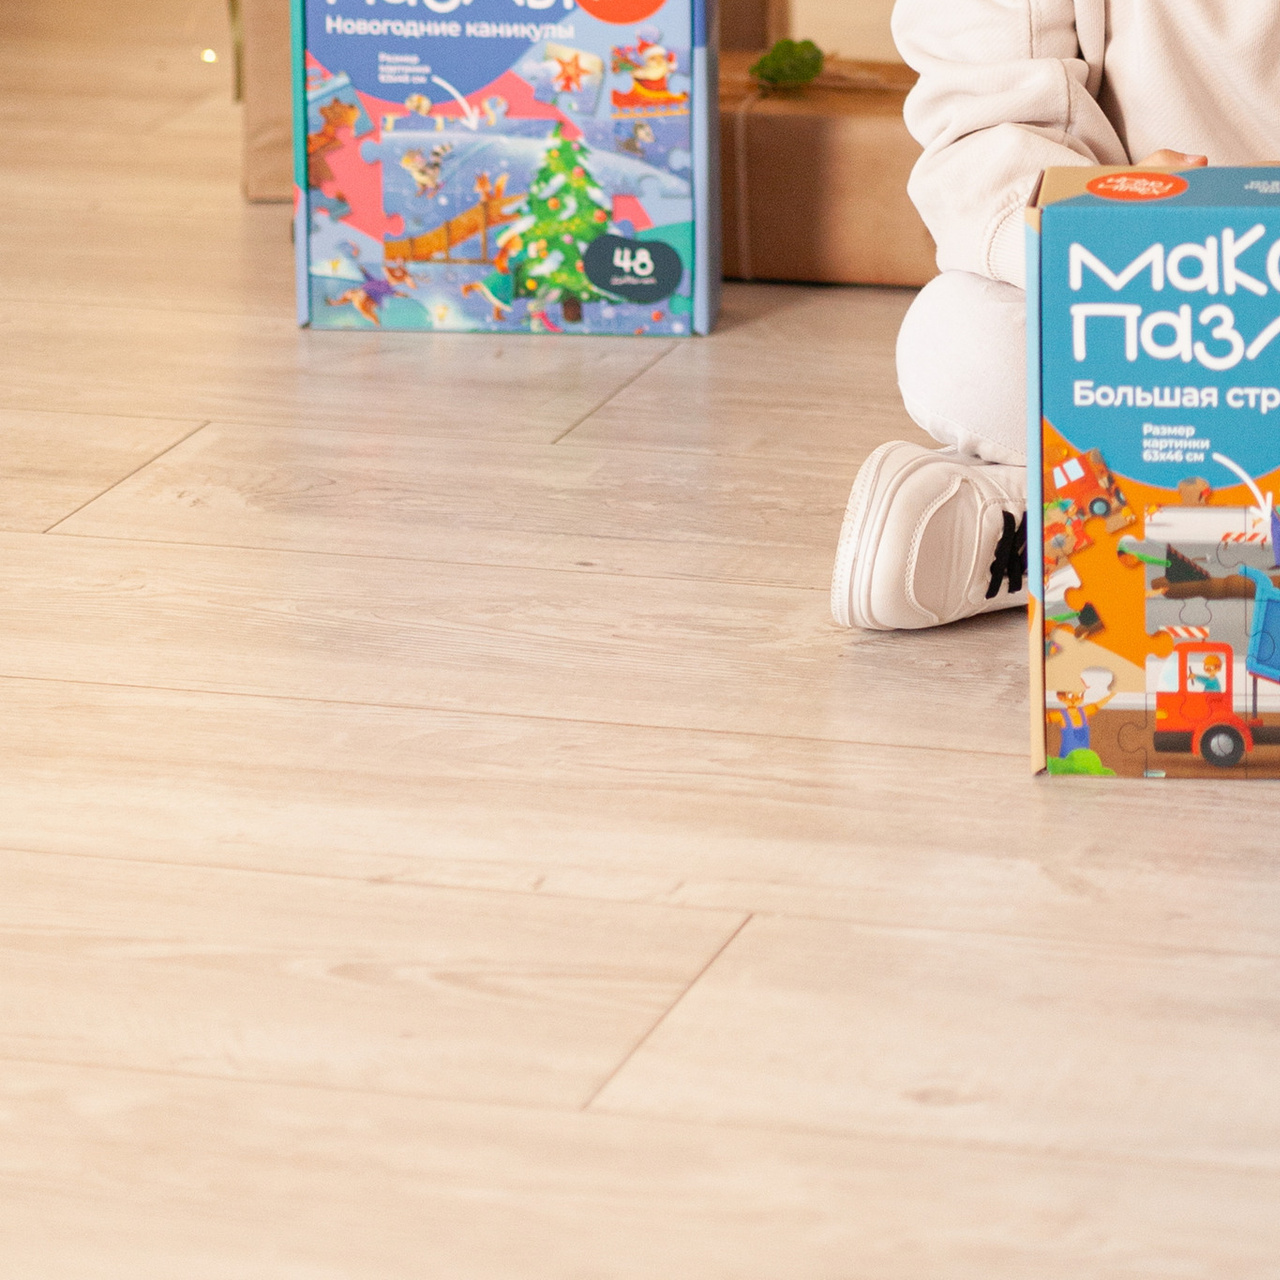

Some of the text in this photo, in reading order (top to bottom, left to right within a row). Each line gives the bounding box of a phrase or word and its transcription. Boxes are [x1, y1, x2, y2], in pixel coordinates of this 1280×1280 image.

[326, 15, 575, 42] Новогодние каникулы
[613, 247, 655, 277] 48
[1073, 380, 1218, 408] Большая
[1142, 423, 1196, 437] Размер
[1142, 438, 1210, 450] картинки
[1186, 451, 1204, 462] см
